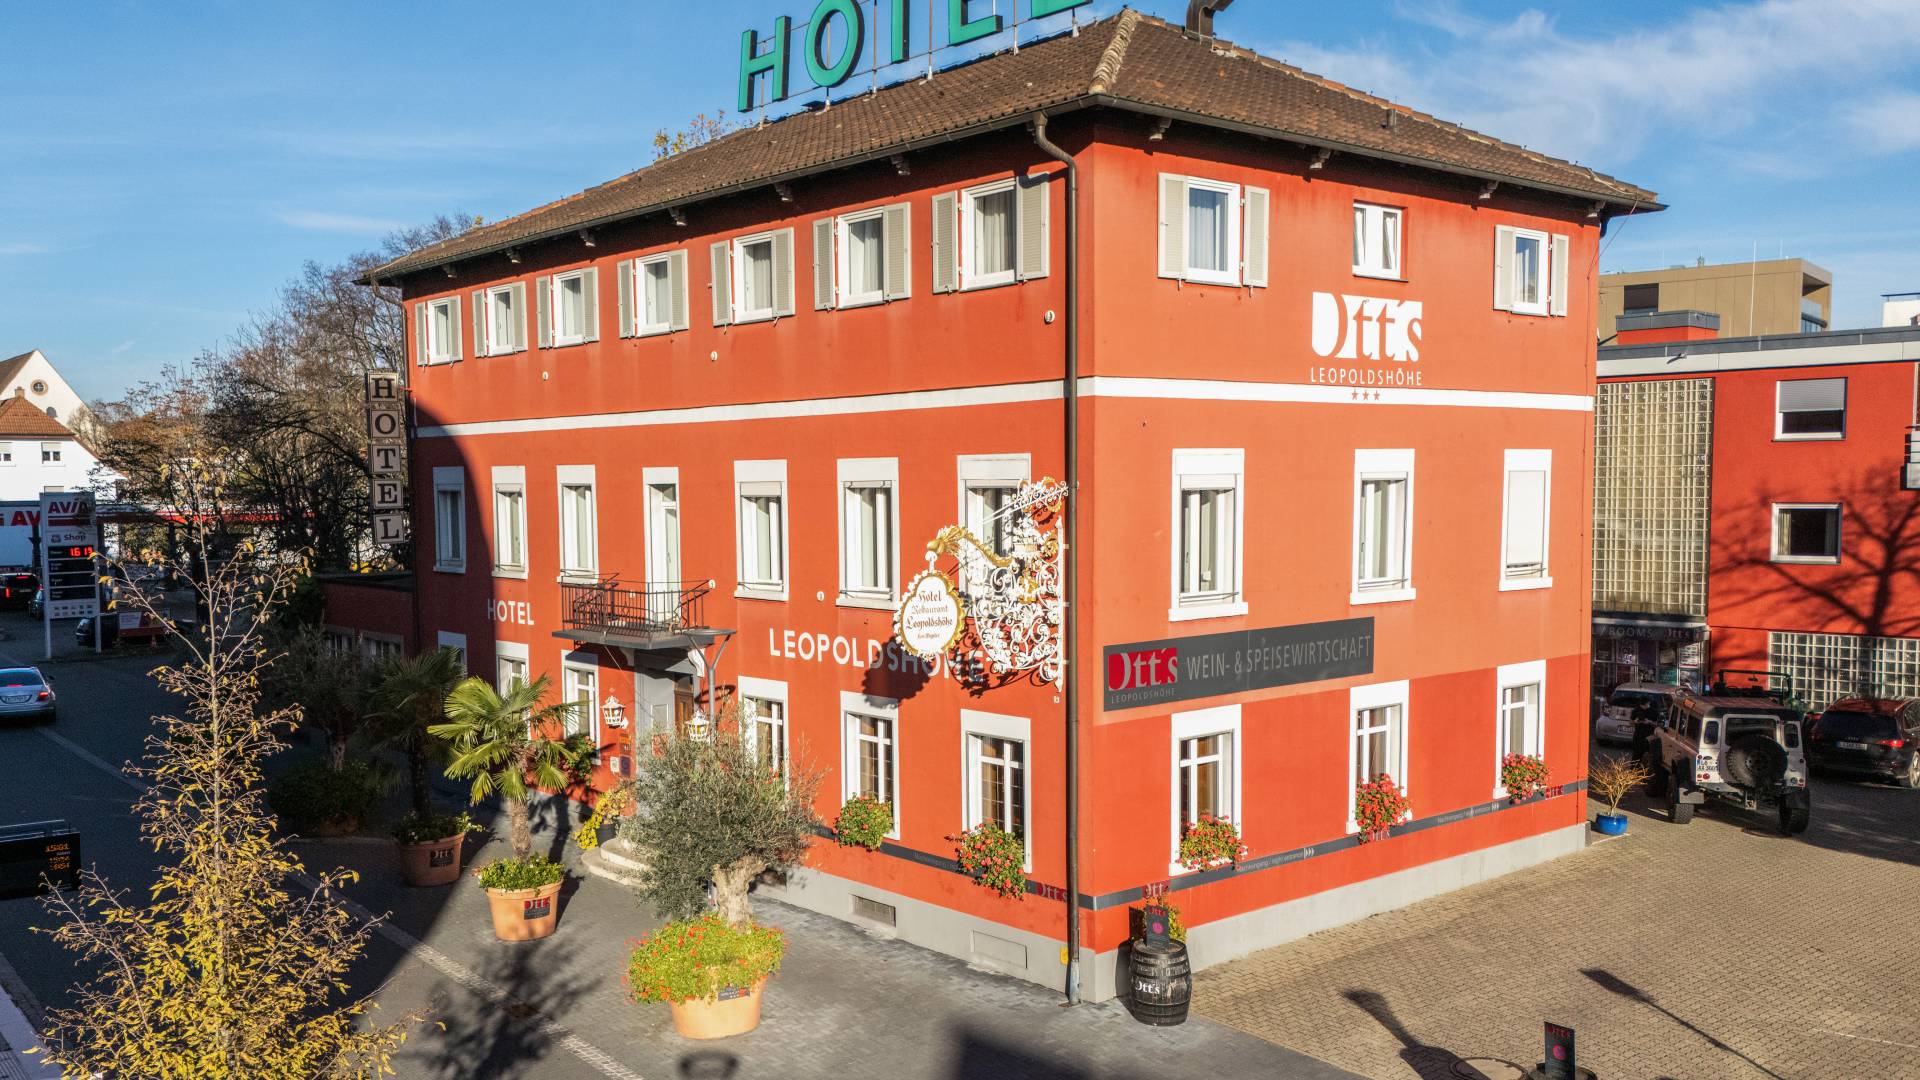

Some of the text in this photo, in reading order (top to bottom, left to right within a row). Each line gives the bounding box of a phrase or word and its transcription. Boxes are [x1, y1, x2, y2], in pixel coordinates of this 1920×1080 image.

[371, 377, 400, 540] HOTEL
[48, 501, 88, 514] AVIA
[487, 598, 535, 626] HOTEL
[1246, 635, 1372, 673] SPEISEWIRTSCHAFT
